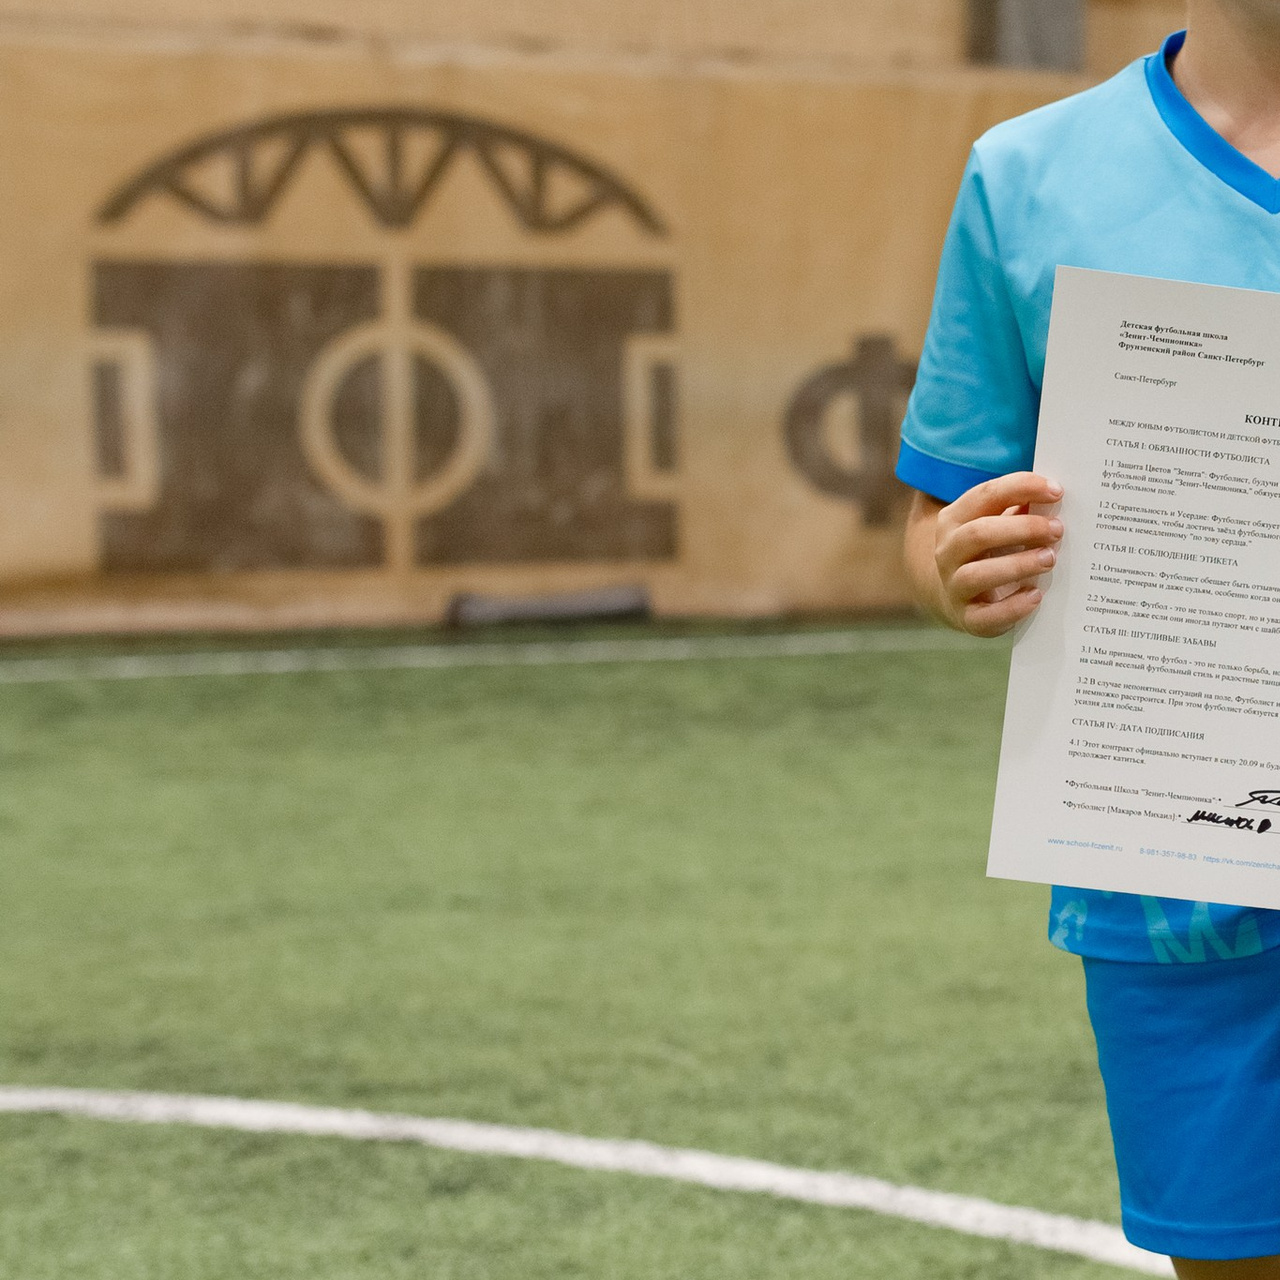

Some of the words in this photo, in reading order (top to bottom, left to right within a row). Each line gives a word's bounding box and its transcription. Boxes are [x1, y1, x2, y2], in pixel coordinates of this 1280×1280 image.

[1119, 331, 1203, 347] «Зенит-Чемпионика»
[1120, 320, 1153, 331] Детская
[1154, 325, 1201, 337] футбольная
[1202, 332, 1228, 341] школа
[1118, 341, 1171, 354] Фрунзенский
[1172, 349, 1196, 357] район
[1197, 351, 1265, 368] Санкт-Петербург
[1114, 372, 1177, 388] Санкт-Петербург
[1108, 418, 1136, 428] МЕЖДУ
[1137, 422, 1163, 431] ЮНЫМ
[1163, 425, 1219, 438] ФУТБОЛИСТОМ
[1226, 433, 1261, 444] ДЕТСКОЙ
[1106, 438, 1140, 449] СТАТЬЯ
[1148, 443, 1211, 458] ОБЯЗАННОСТИ
[1212, 451, 1270, 465] ФУТБОЛИСТА
[1102, 469, 1147, 482] футбольной
[1147, 477, 1174, 485] школы
[1104, 459, 1114, 467] 1.1
[1116, 460, 1144, 471] Защита
[1145, 464, 1172, 474] Цветов
[1208, 472, 1250, 485] Футболист,
[1251, 477, 1279, 488] будучи
[1111, 481, 1156, 493] футбольном
[1157, 488, 1175, 496] поле.
[1099, 500, 1110, 509] 1.2
[1110, 502, 1169, 516] Старательность
[1177, 510, 1208, 521] Усердие:
[1211, 514, 1251, 526] Футболист
[1161, 520, 1185, 528] чтобы
[1095, 523, 1127, 532] готовым
[1134, 528, 1187, 541] немедленному
[1093, 542, 1127, 553] СТАТЬЯ
[1128, 546, 1136, 554] II:
[1137, 547, 1197, 561] СОБЛЮДЕНИЕ
[1199, 555, 1238, 567] ЭТИКЕТА
[1090, 562, 1101, 571] 2.1
[1158, 571, 1199, 583] Футболист
[1199, 576, 1231, 587] обещает
[1089, 575, 1122, 584] команде,
[1124, 579, 1158, 589] тренерам
[1165, 584, 1184, 592] даже
[1184, 587, 1213, 595] судьям,
[1214, 589, 1249, 599] особенно
[1250, 594, 1271, 602] когда
[1085, 606, 1130, 617] соперников,
[1131, 611, 1150, 619] даже
[1211, 621, 1238, 630] путают
[1087, 593, 1099, 602] 2.2
[1100, 595, 1137, 606] Уважение:
[1140, 600, 1168, 610] Футбол
[1198, 609, 1223, 617] только
[1224, 612, 1247, 621] спорт,
[1083, 625, 1117, 636] СТАТЬЯ
[1118, 628, 1127, 637] III:
[1130, 630, 1181, 643] ШУТЛИВЫЕ
[1182, 636, 1217, 648] ЗАБАВЫ
[1081, 645, 1091, 653] 3.1
[1160, 655, 1188, 665] футбол
[1218, 663, 1243, 672] только
[1243, 664, 1271, 676] борьба,
[1146, 663, 1192, 676] футбольный
[1221, 674, 1260, 684] радостные
[1077, 676, 1089, 685] 3.2
[1097, 680, 1122, 689] случае
[1123, 683, 1167, 694] непонятных
[1168, 689, 1203, 698] ситуаций
[1214, 694, 1233, 702] поле,
[1234, 695, 1275, 707] Футболист
[1074, 698, 1100, 707] усилия
[1115, 703, 1143, 712] победы.
[1168, 697, 1184, 707] При
[1203, 702, 1242, 713] футболист
[1243, 707, 1279, 718] обязуется
[1071, 718, 1105, 728] СТАТЬЯ
[1106, 721, 1118, 730] IV:
[1119, 723, 1143, 733] ДАТА
[1144, 726, 1205, 740] ПОДПИСАНИЯ
[1068, 750, 1111, 760] продолжает
[1113, 755, 1144, 764] катиться.
[1069, 738, 1080, 746] 4.1
[1082, 739, 1100, 749] Этот
[1101, 744, 1134, 753] контракт
[1135, 746, 1180, 758] официально
[1181, 753, 1213, 762] вступает
[1219, 758, 1237, 766] силу
[1238, 758, 1259, 767] 20.09
[1113, 785, 1139, 795] Школа
[1106, 805, 1142, 817] [Макаров
